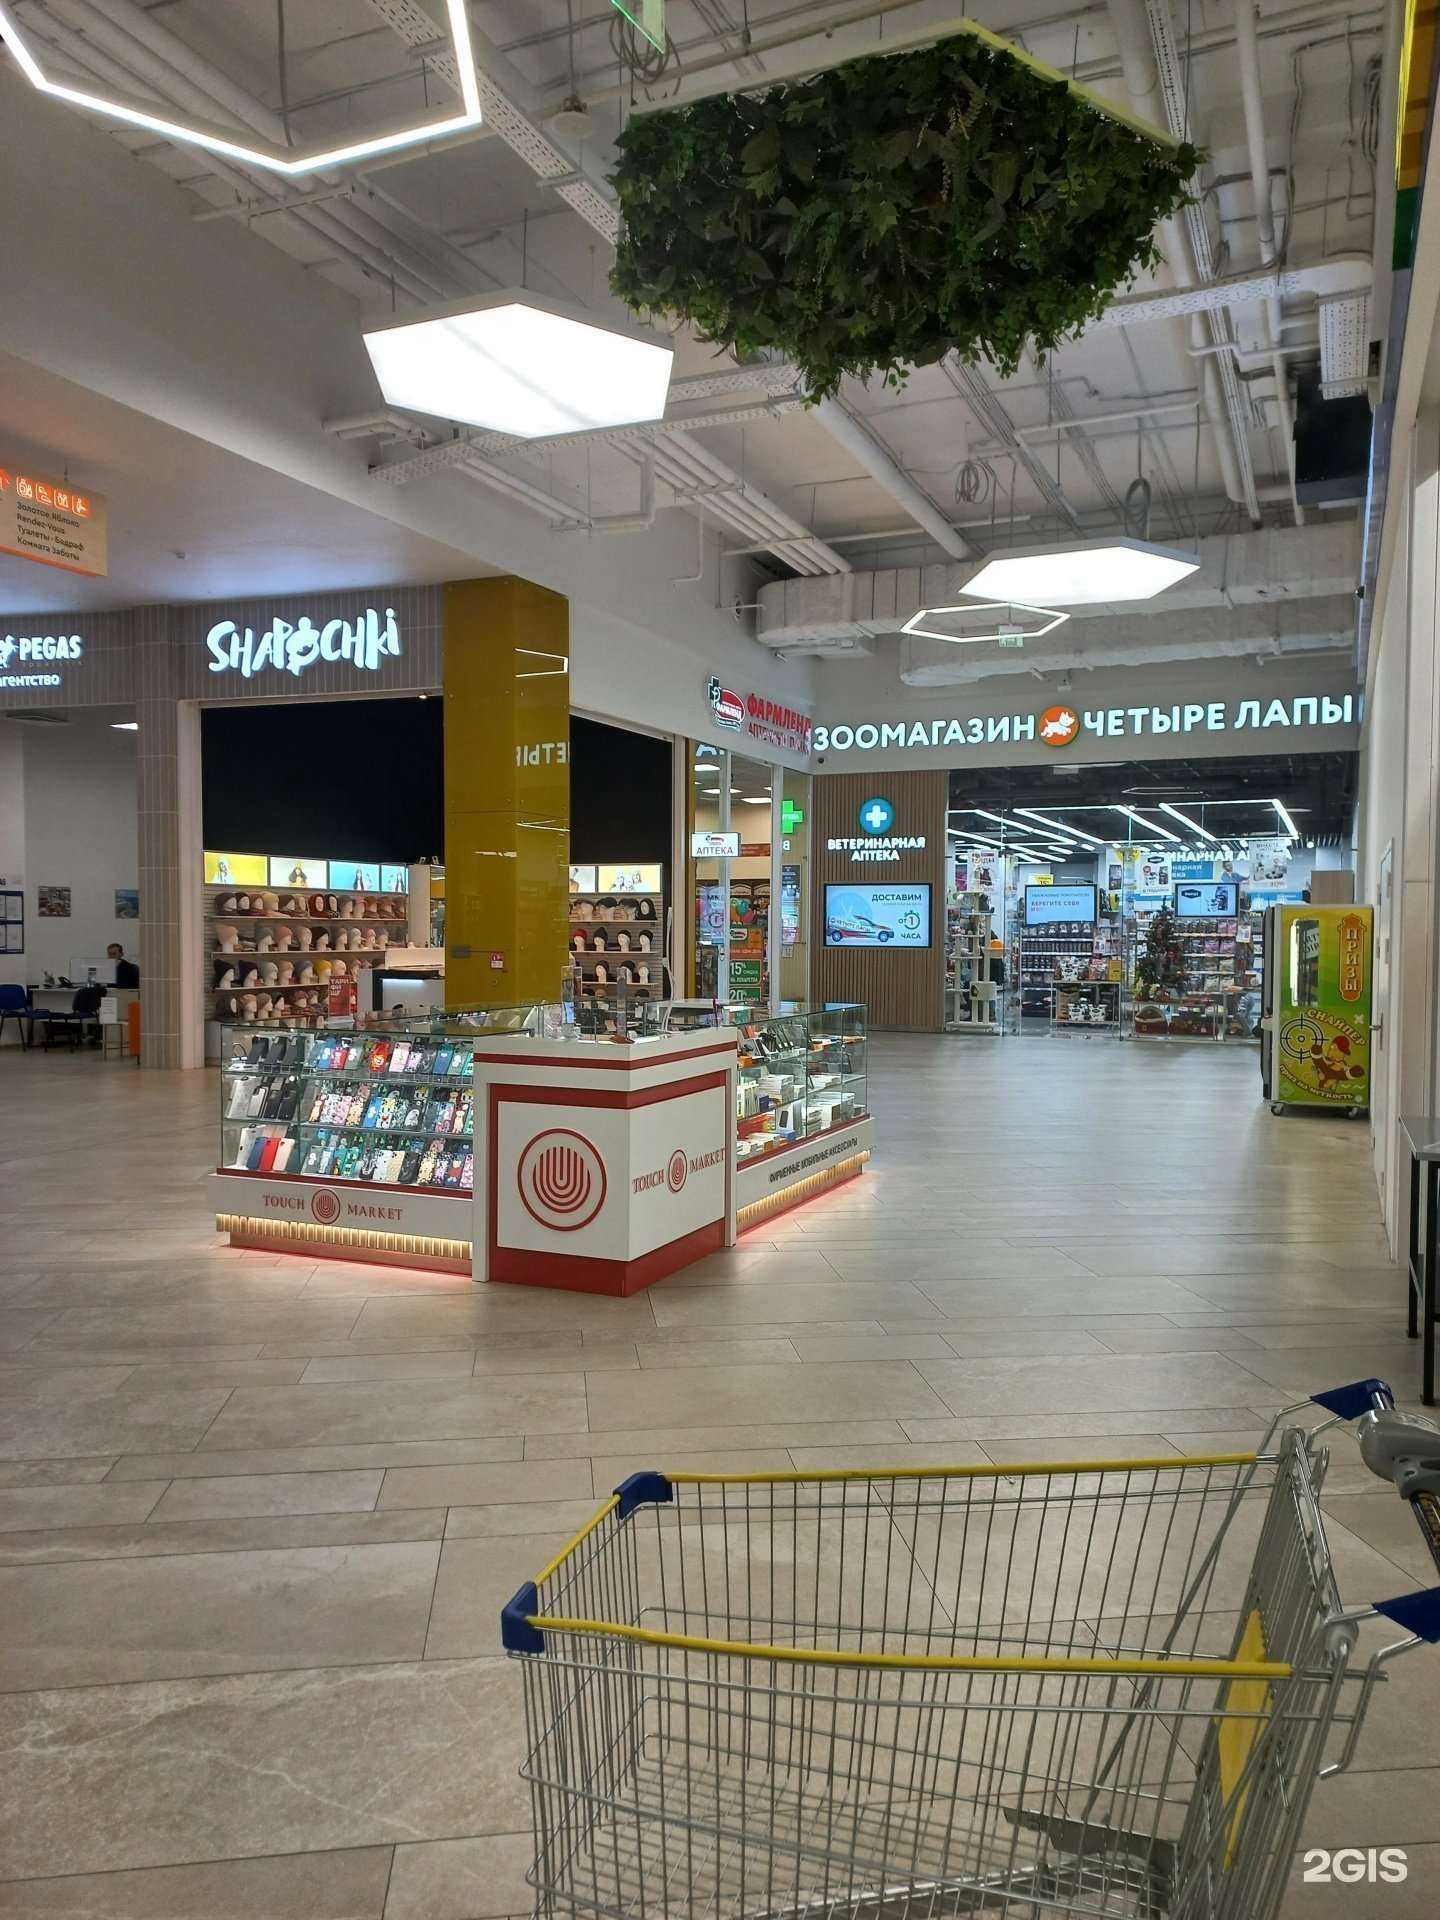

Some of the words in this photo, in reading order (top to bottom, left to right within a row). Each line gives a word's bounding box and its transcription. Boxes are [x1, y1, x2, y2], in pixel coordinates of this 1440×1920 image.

[19, 635, 82, 661] PEGAS
[813, 715, 1035, 751] ЗООМАГАЗИН
[1084, 702, 1226, 737] ЧЕТЫРЕ
[1234, 695, 1353, 729] ЛАПЫ
[696, 847, 734, 855] АПТЕКА
[827, 837, 926, 850] ВЕТЕРИНАРНАЯ
[851, 850, 900, 861] АПТЕКА
[872, 894, 922, 902] ДОСТАВИМ
[1346, 928, 1359, 991] ПРИЗЫ
[1307, 1009, 1366, 1046] СНАЙПЕР
[632, 1169, 665, 1193] TOUCH
[689, 1147, 725, 1173] MARKET
[262, 1194, 305, 1210] TOUCH
[347, 1204, 403, 1220] MARKET
